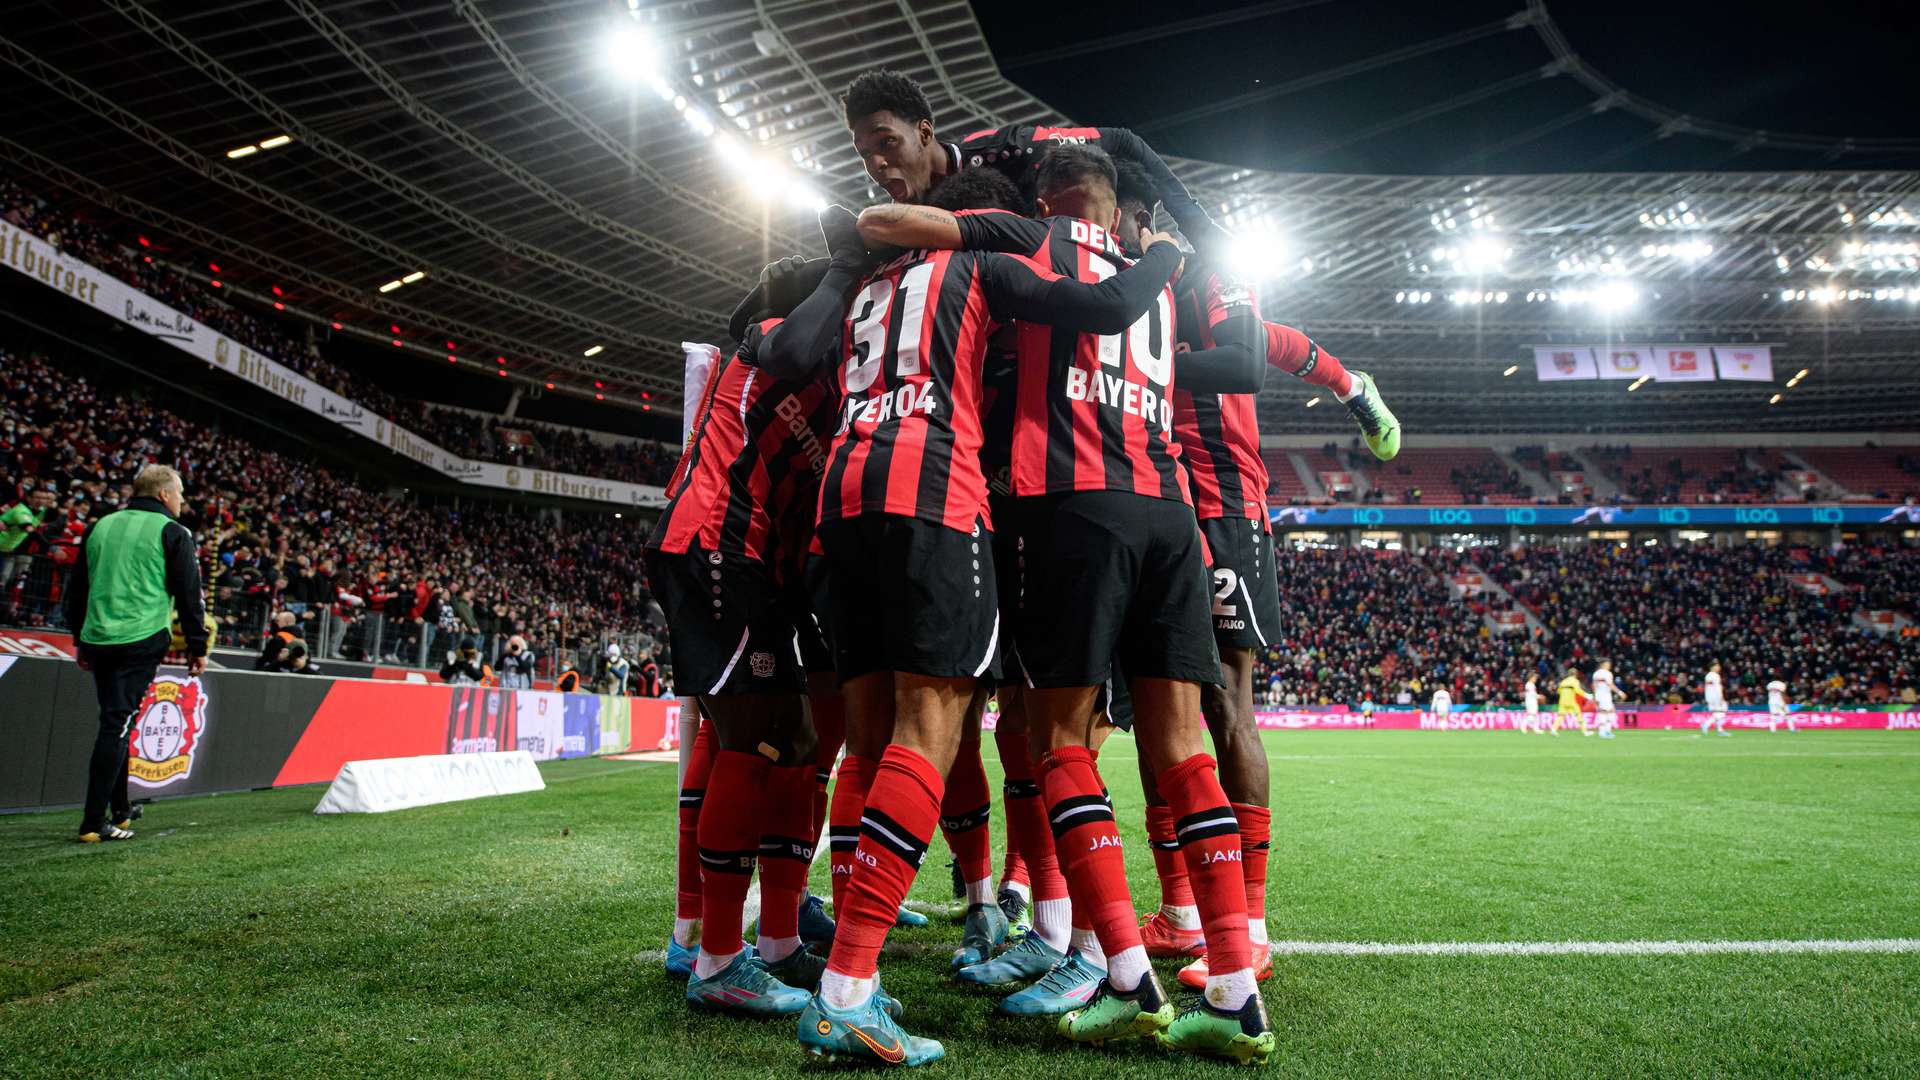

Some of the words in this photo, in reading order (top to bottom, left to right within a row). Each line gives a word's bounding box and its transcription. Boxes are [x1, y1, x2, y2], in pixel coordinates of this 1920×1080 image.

[845, 262, 935, 393] 31
[238, 349, 307, 404] Bitburger
[895, 380, 937, 418] 04
[1066, 367, 1157, 424] BAYER
[1161, 398, 1174, 443] 0
[533, 471, 614, 500] Bitburger
[1217, 619, 1246, 631] JAKO
[145, 726, 179, 737] BAYER
[1201, 849, 1243, 865] JAKO
